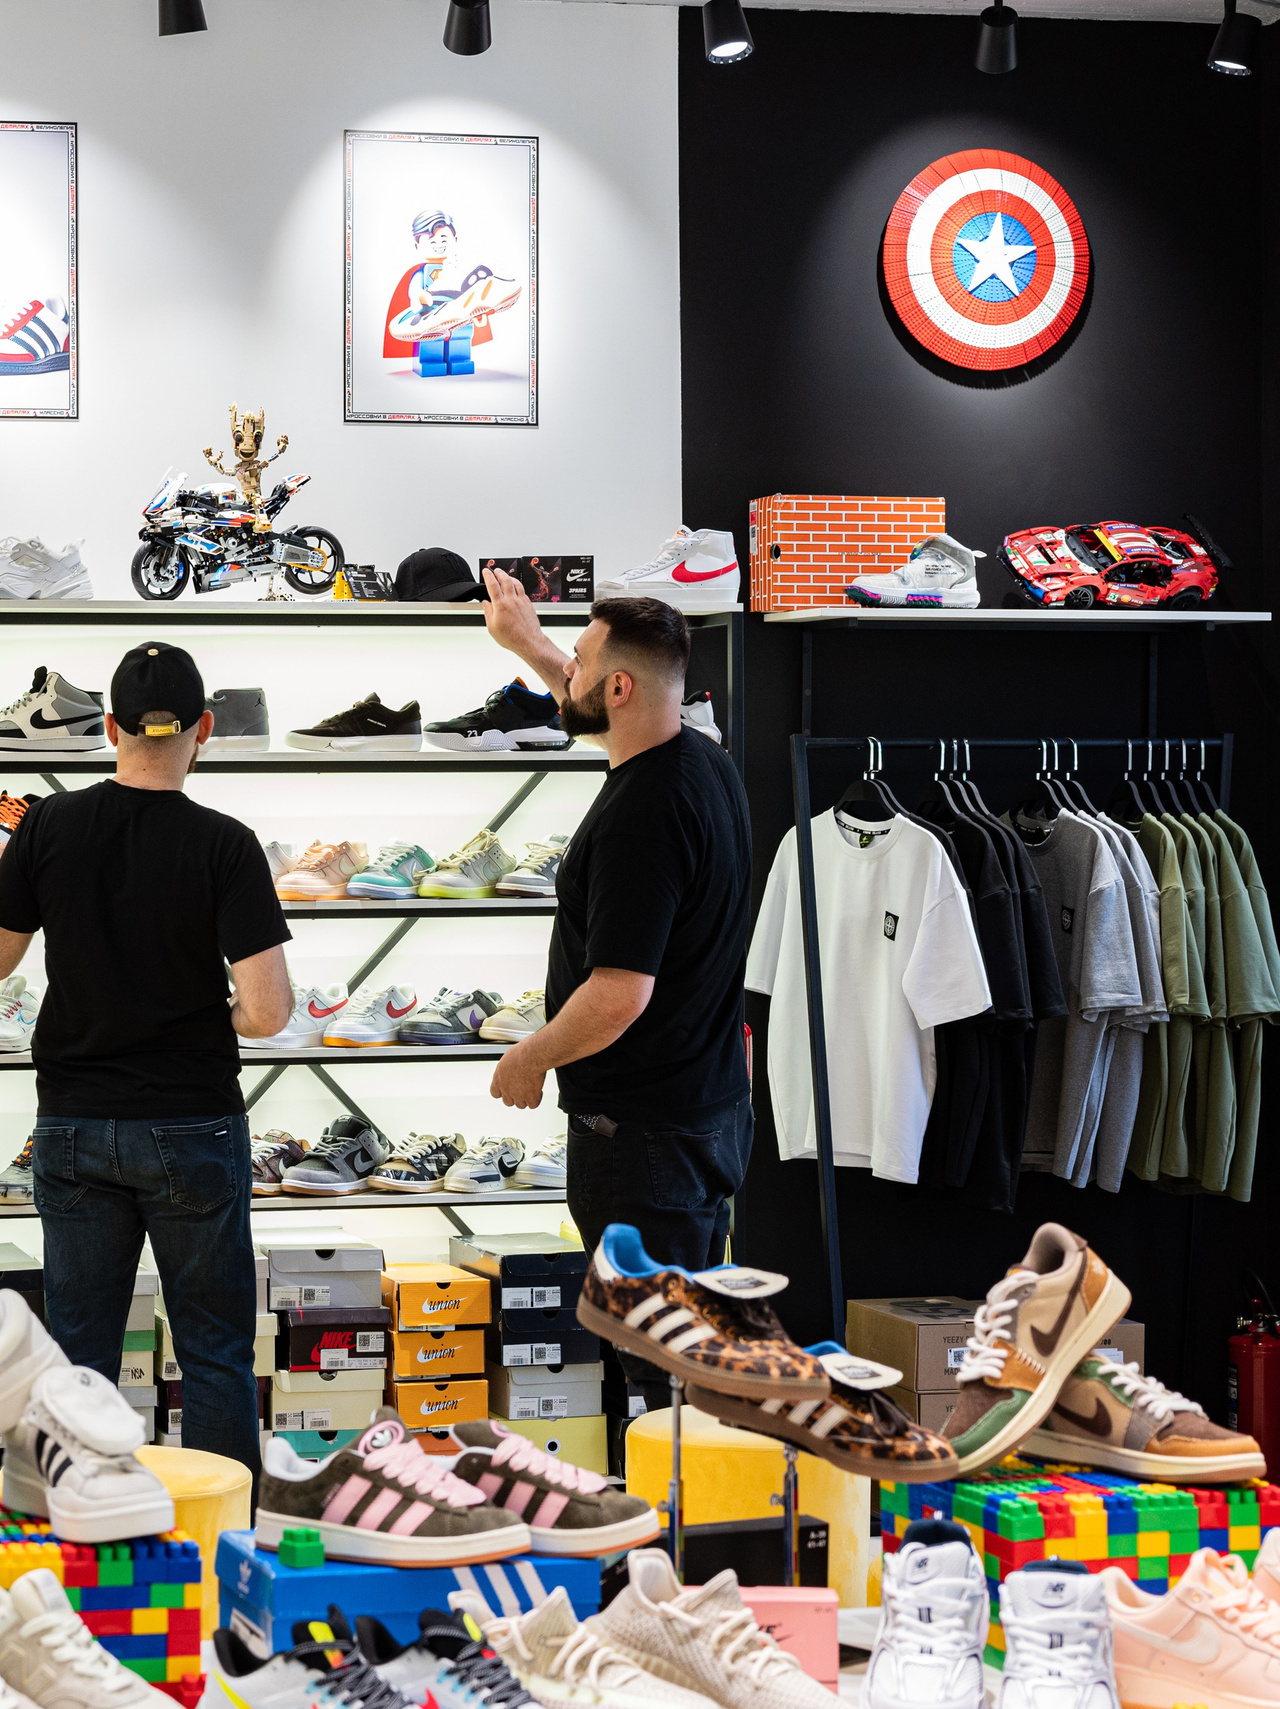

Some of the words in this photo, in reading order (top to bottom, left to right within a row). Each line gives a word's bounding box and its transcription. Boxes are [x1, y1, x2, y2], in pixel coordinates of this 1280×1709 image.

[429, 1295, 461, 1312] union
[321, 1332, 354, 1348] NIKE
[943, 1336, 964, 1344] YEEZY
[423, 1344, 455, 1361] union
[427, 1395, 459, 1412] union
